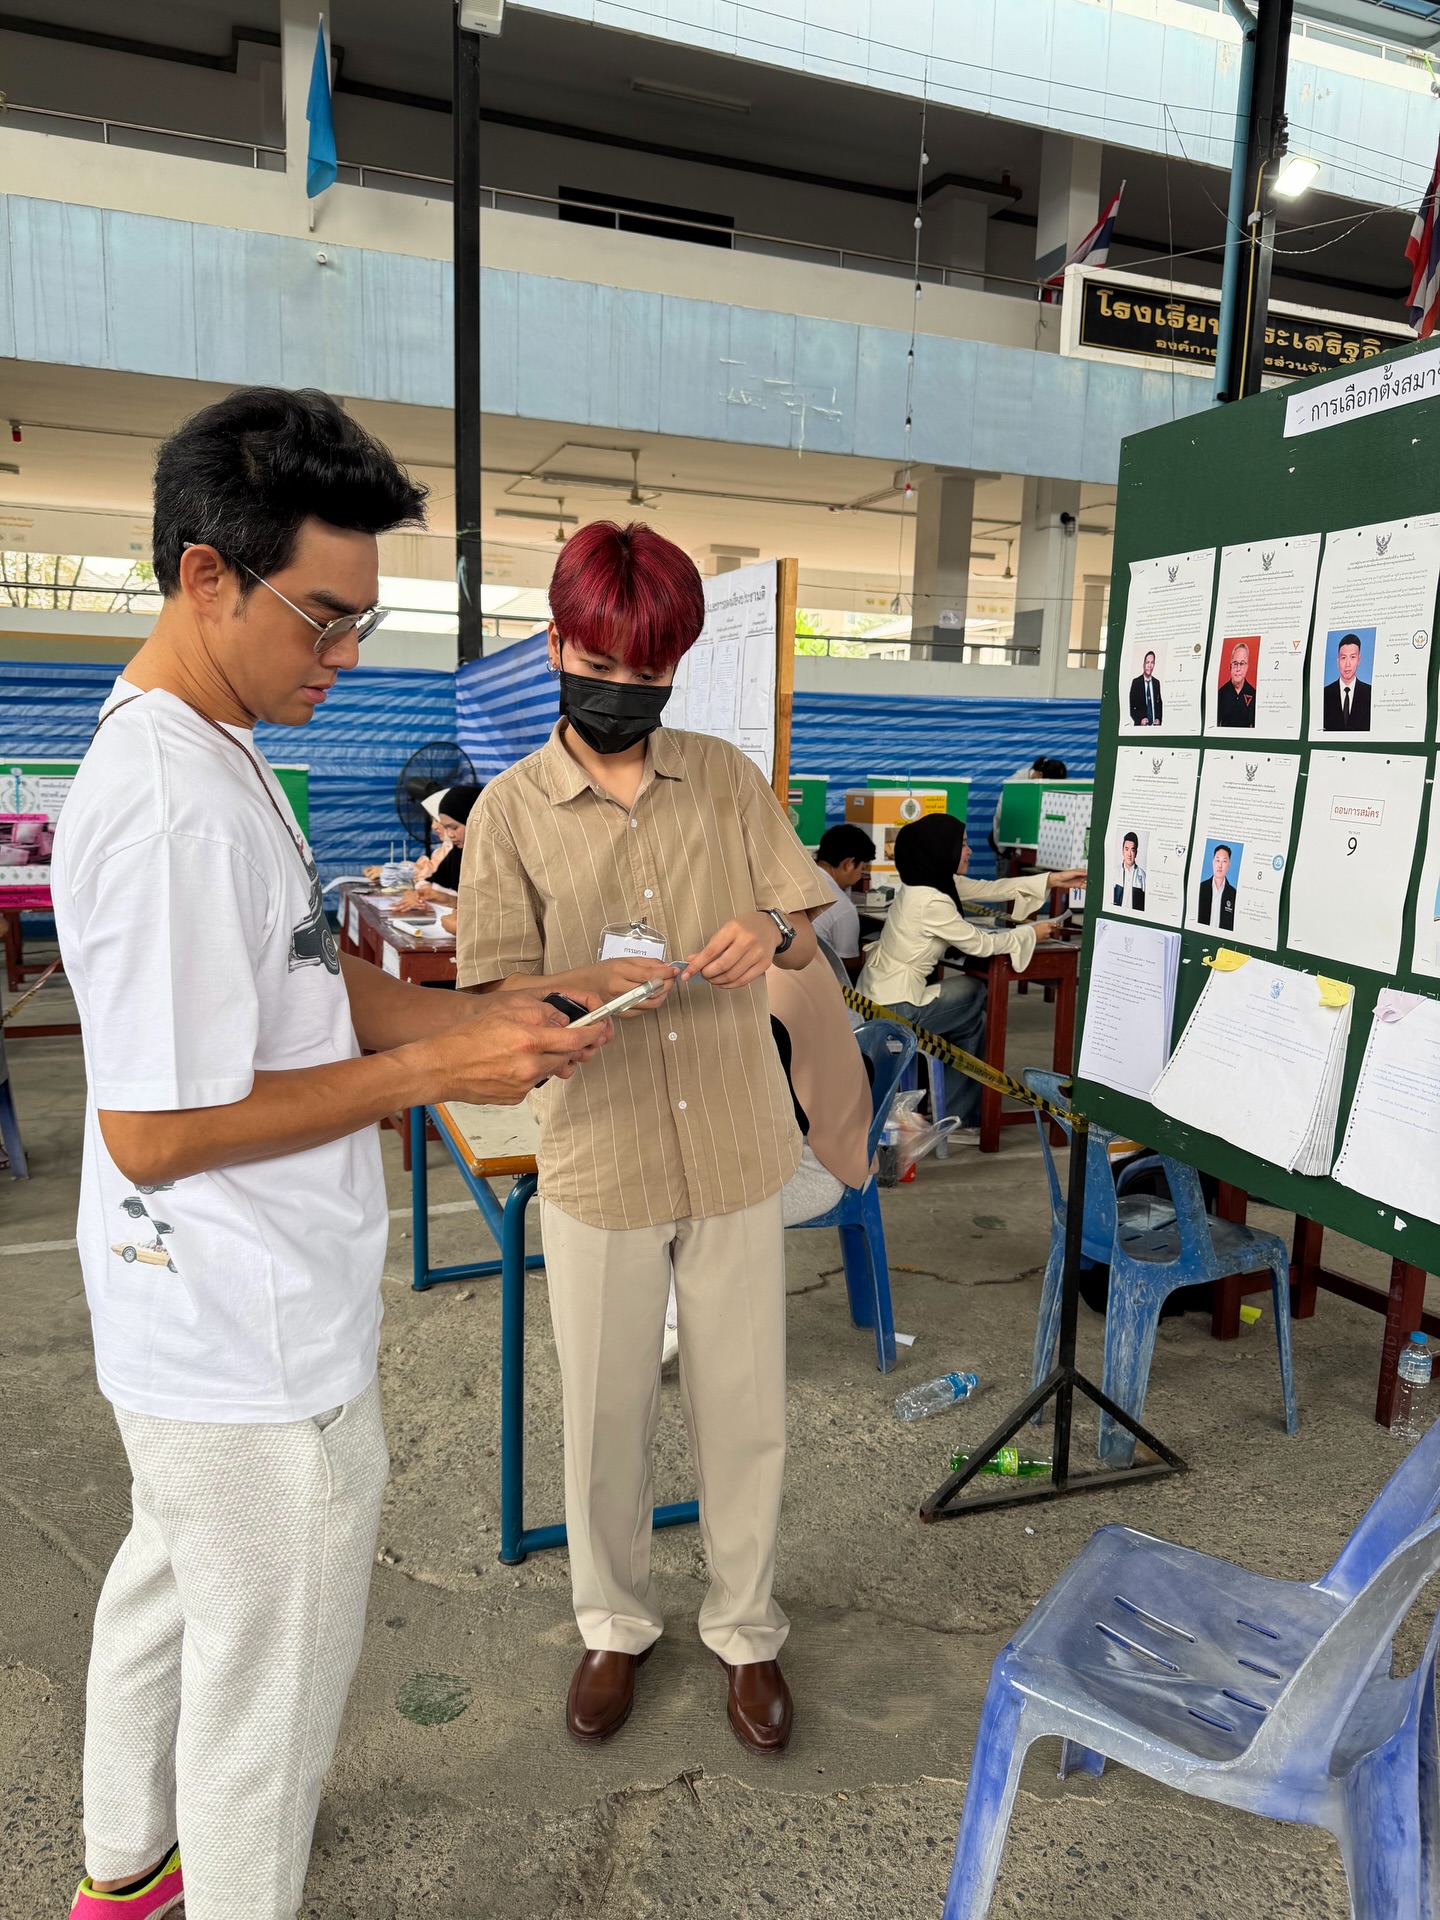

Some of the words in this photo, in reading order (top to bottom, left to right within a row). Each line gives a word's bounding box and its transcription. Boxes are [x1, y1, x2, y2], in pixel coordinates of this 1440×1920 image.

[1311, 364, 1440, 421] การเลือกตั้งสมา
[1273, 660, 1280, 670] 2
[1393, 653, 1400, 665] 3
[1334, 806, 1380, 819] ถอนการสมัคร
[1346, 836, 1358, 857] 9
[1163, 855, 1168, 864] 7
[1257, 870, 1263, 881] 8
